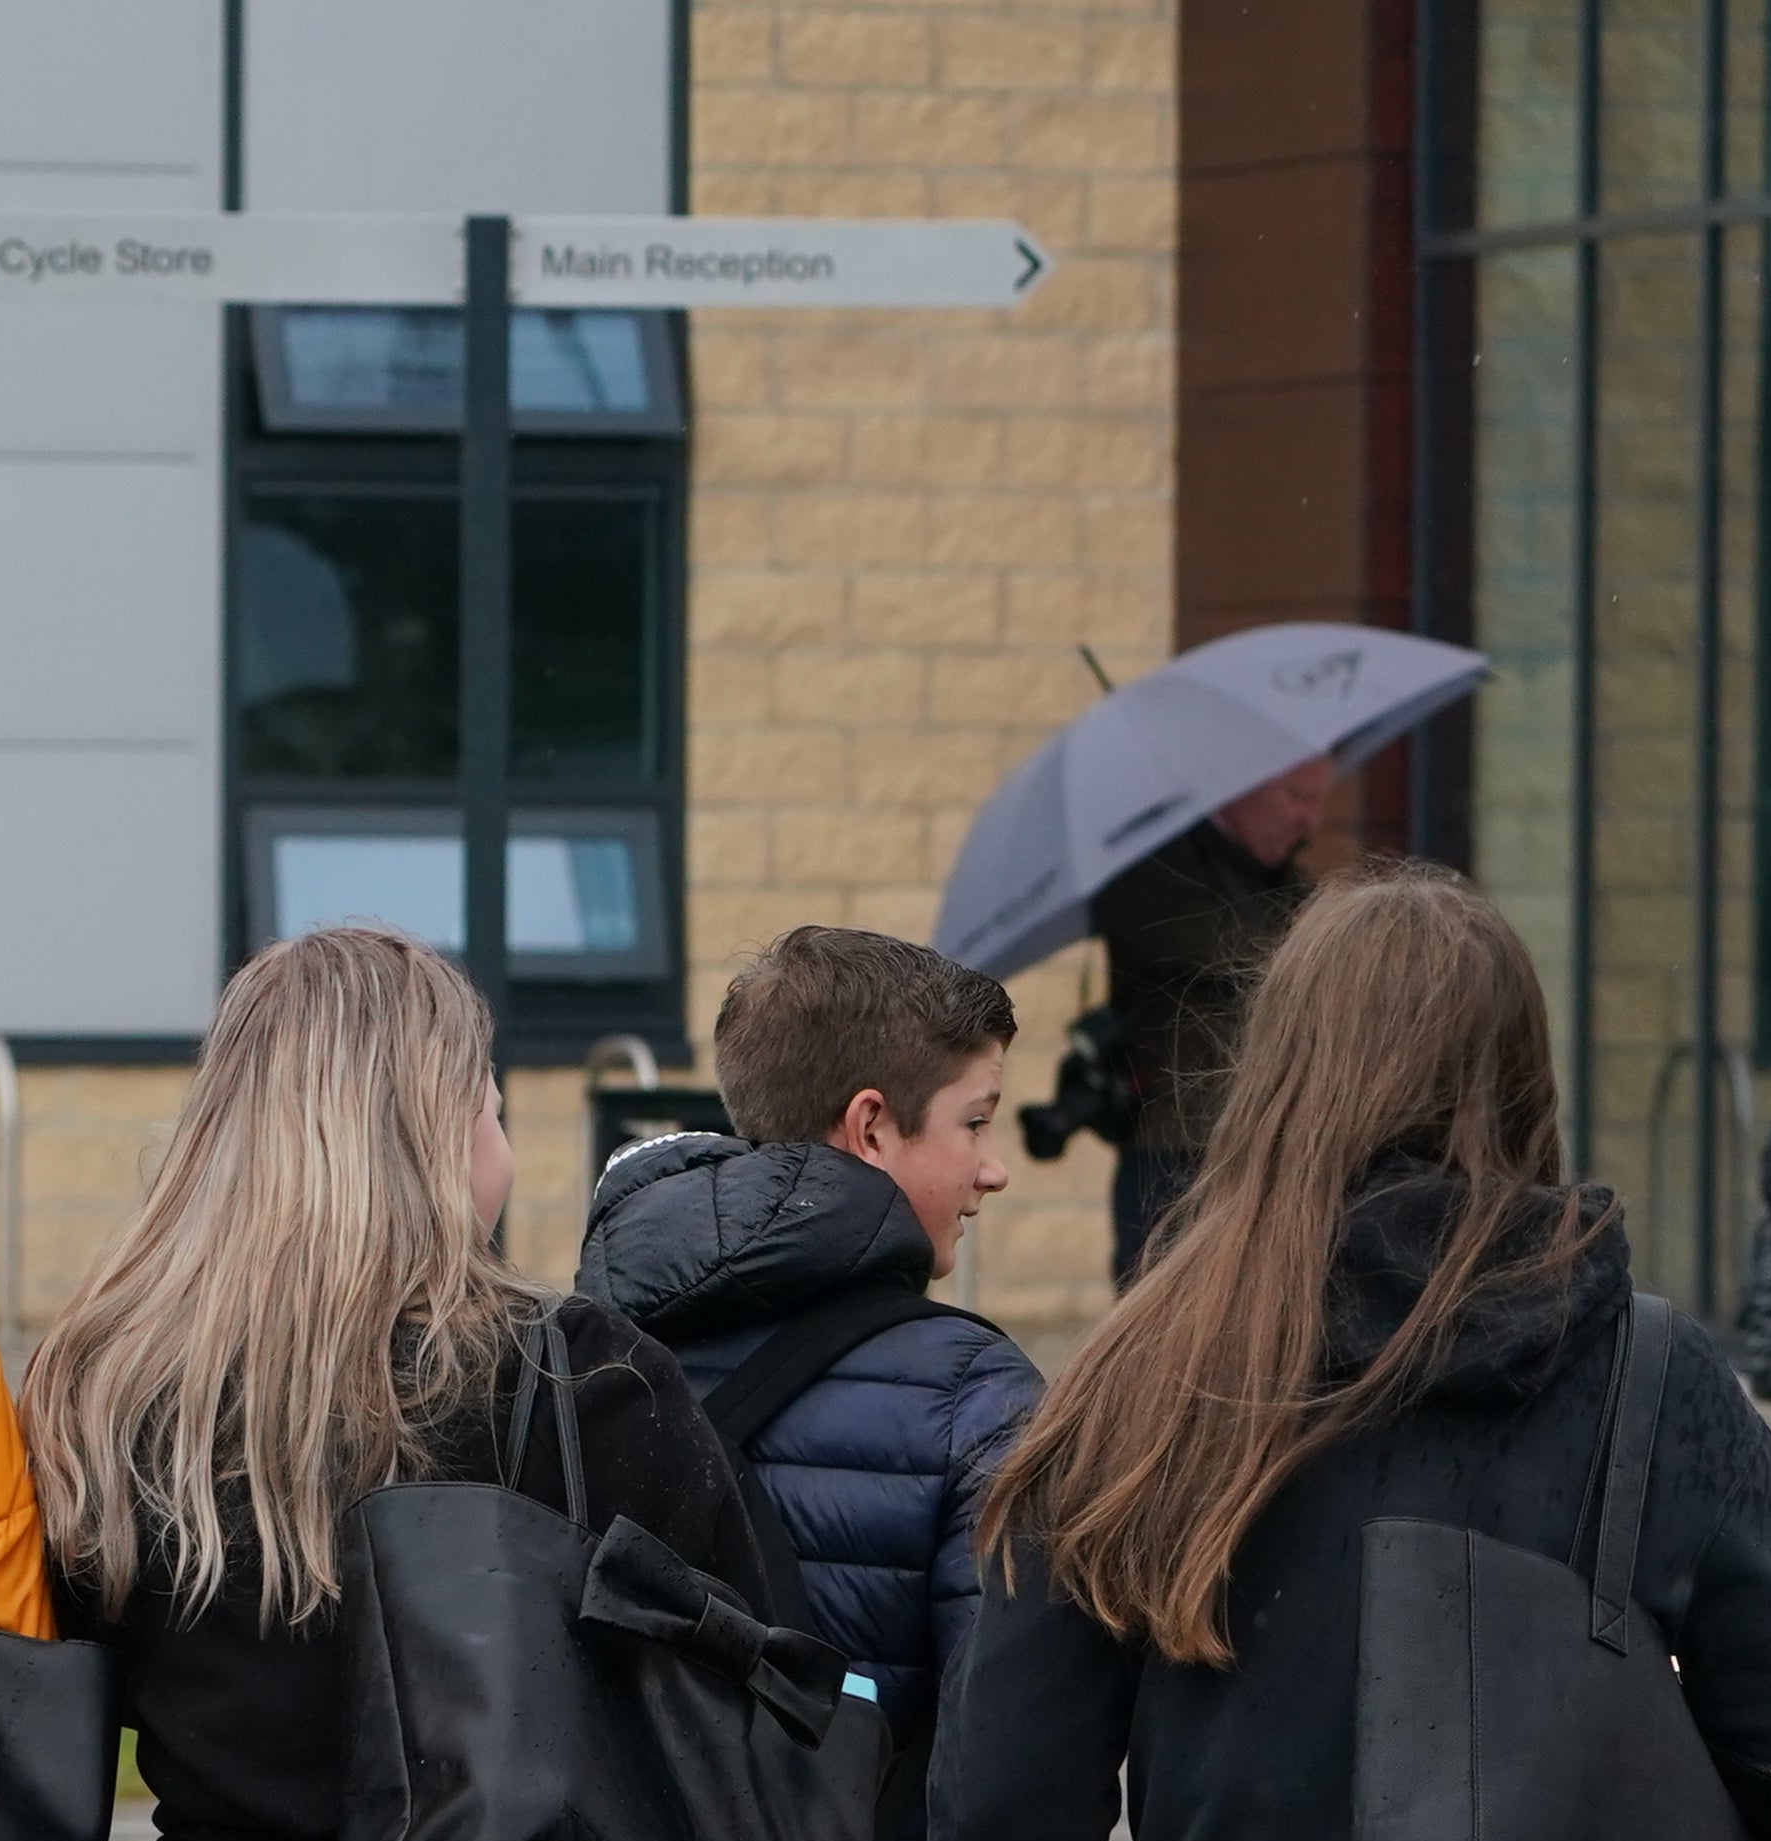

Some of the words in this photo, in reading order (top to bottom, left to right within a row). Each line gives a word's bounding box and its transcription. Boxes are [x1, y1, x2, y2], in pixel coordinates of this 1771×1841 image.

[114, 238, 214, 275] Store
[541, 243, 632, 279] Main
[644, 243, 834, 287] Reception
